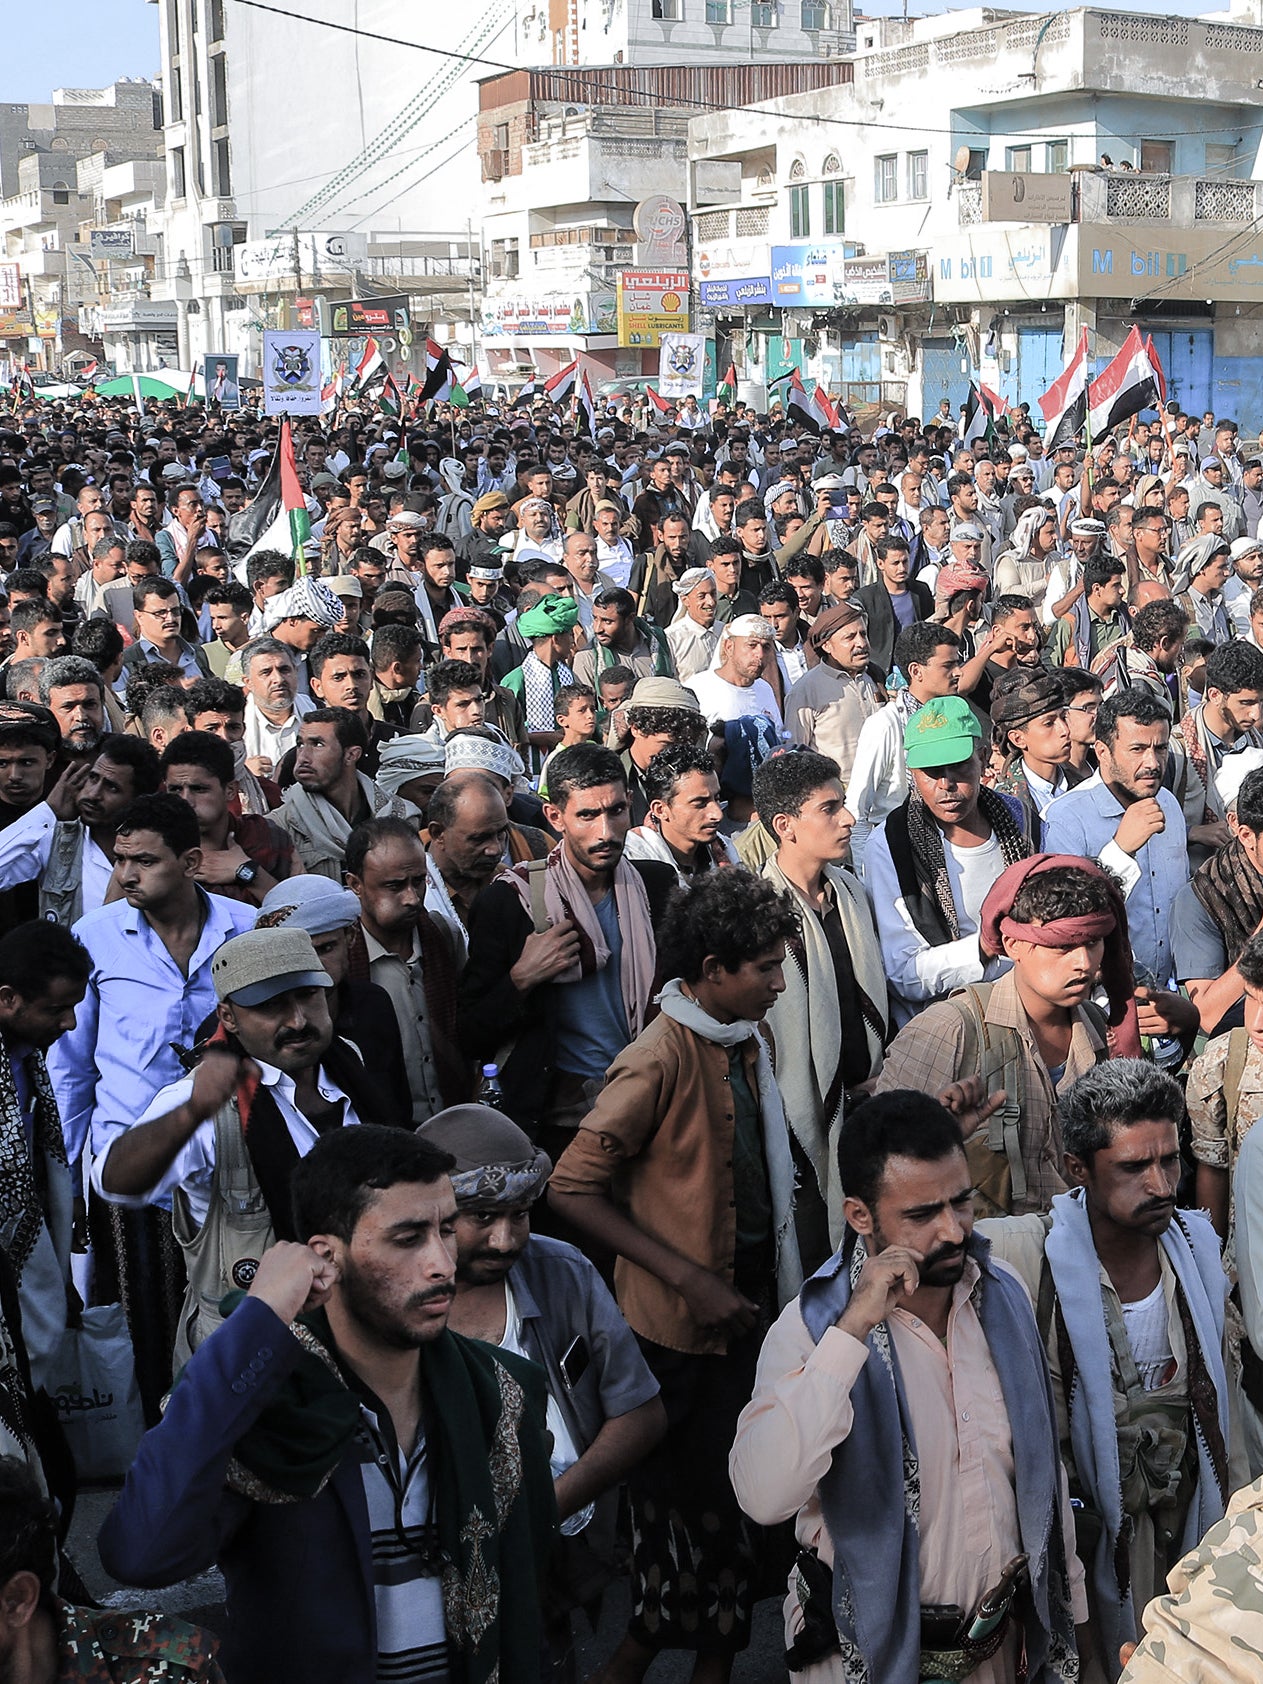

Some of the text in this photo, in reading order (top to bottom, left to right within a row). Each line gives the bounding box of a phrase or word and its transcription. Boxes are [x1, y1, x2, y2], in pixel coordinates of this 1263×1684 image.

[625, 275, 686, 290] الزيلعي
[629, 292, 651, 302] شل
[629, 302, 651, 312] عمان
